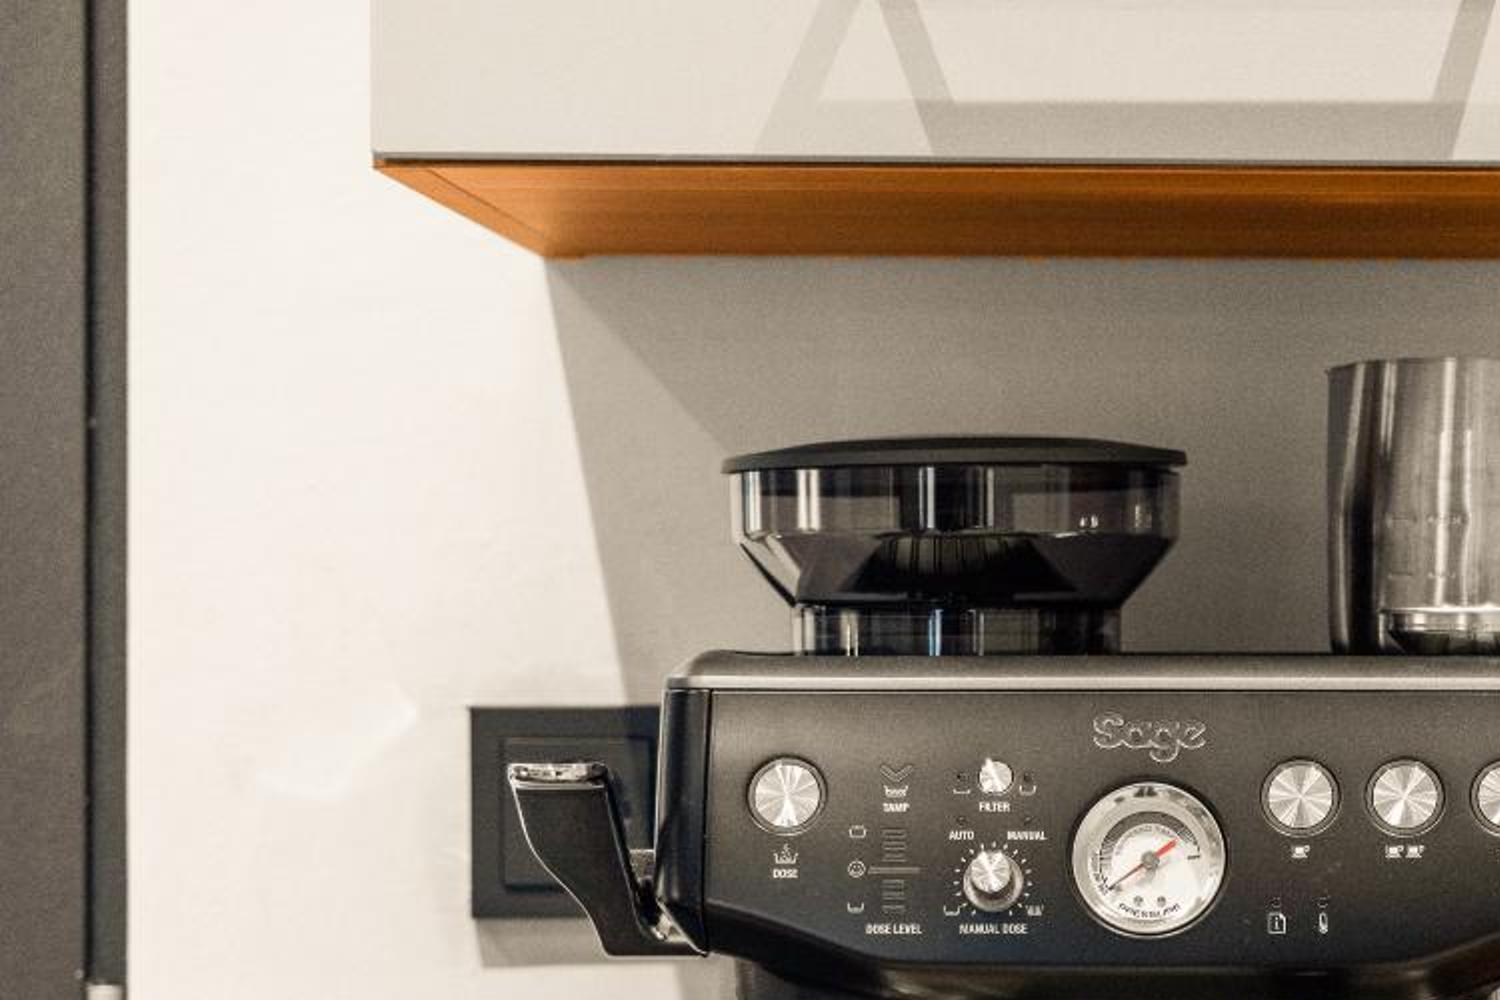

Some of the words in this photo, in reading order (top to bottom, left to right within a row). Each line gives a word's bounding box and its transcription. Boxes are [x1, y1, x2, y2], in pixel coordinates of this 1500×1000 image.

[1092, 715, 1206, 763] Sage
[979, 801, 1011, 813] FILTER
[948, 830, 975, 841] AUTO
[1007, 830, 1048, 841] MANUAL
[773, 868, 799, 879] DOSE
[893, 923, 922, 934] LEVEL
[959, 923, 1000, 935] MANUAL
[1002, 923, 1028, 935] DOSE
